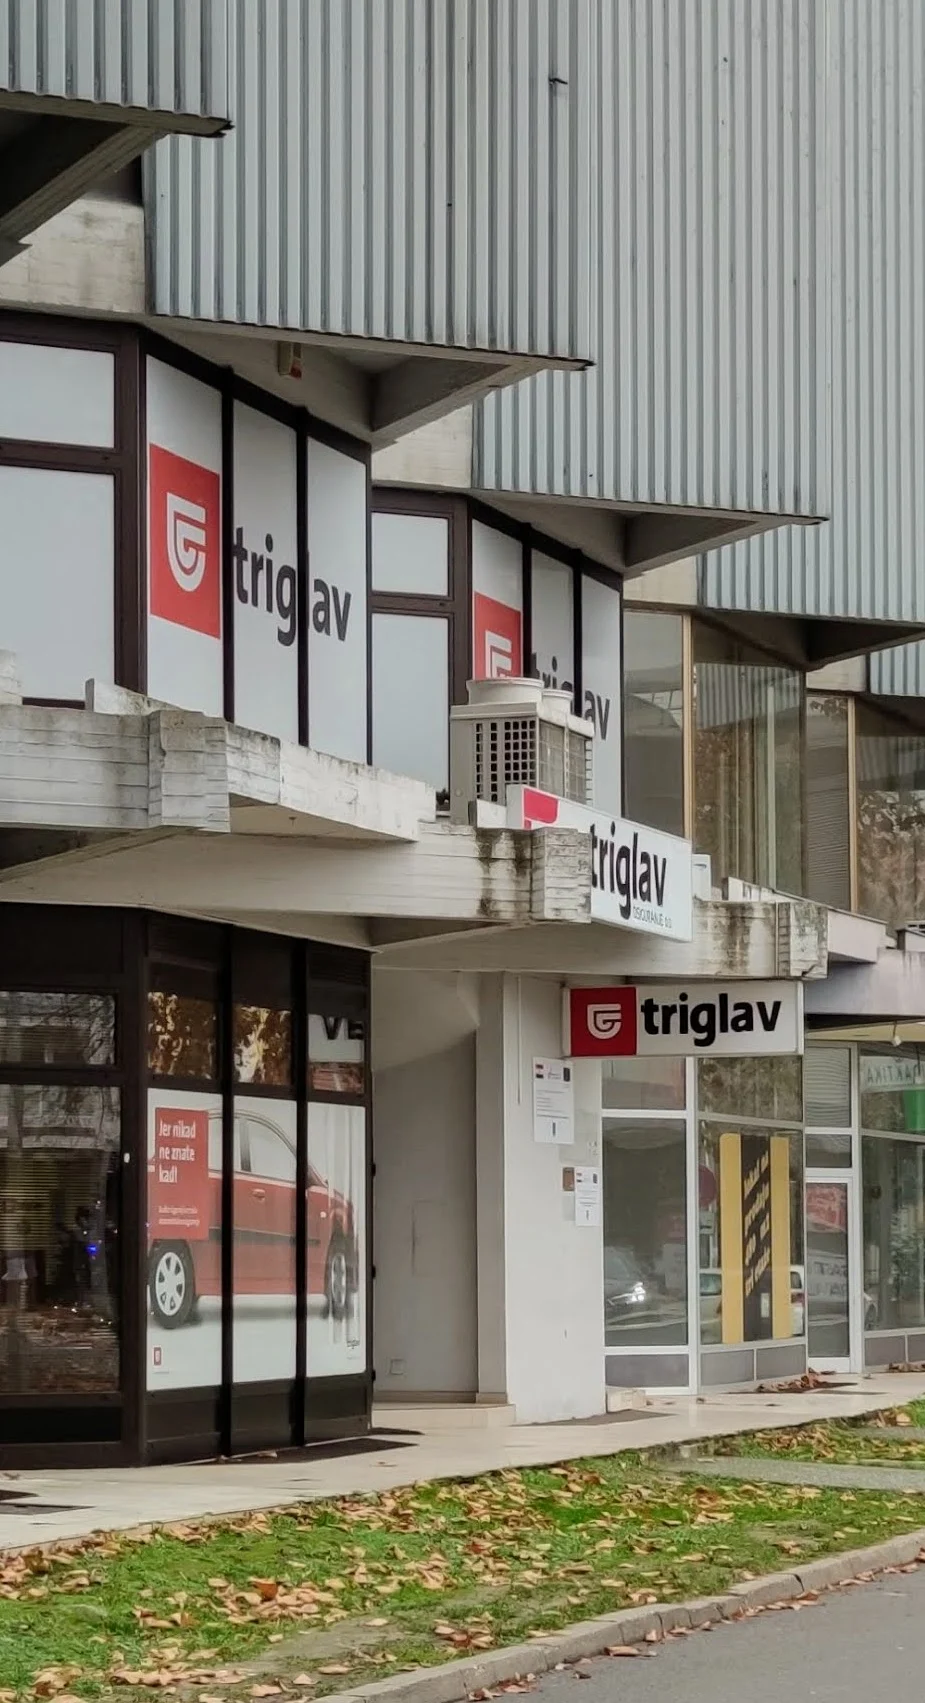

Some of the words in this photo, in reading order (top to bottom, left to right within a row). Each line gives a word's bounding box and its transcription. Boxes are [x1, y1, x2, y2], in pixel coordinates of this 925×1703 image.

[233, 526, 352, 647] trigav
[590, 822, 667, 920] triglav
[641, 992, 782, 1047] triglav
[159, 1119, 171, 1137] Jer
[173, 1120, 196, 1139] nikad
[160, 1146, 170, 1160] ne
[171, 1145, 195, 1162] znate
